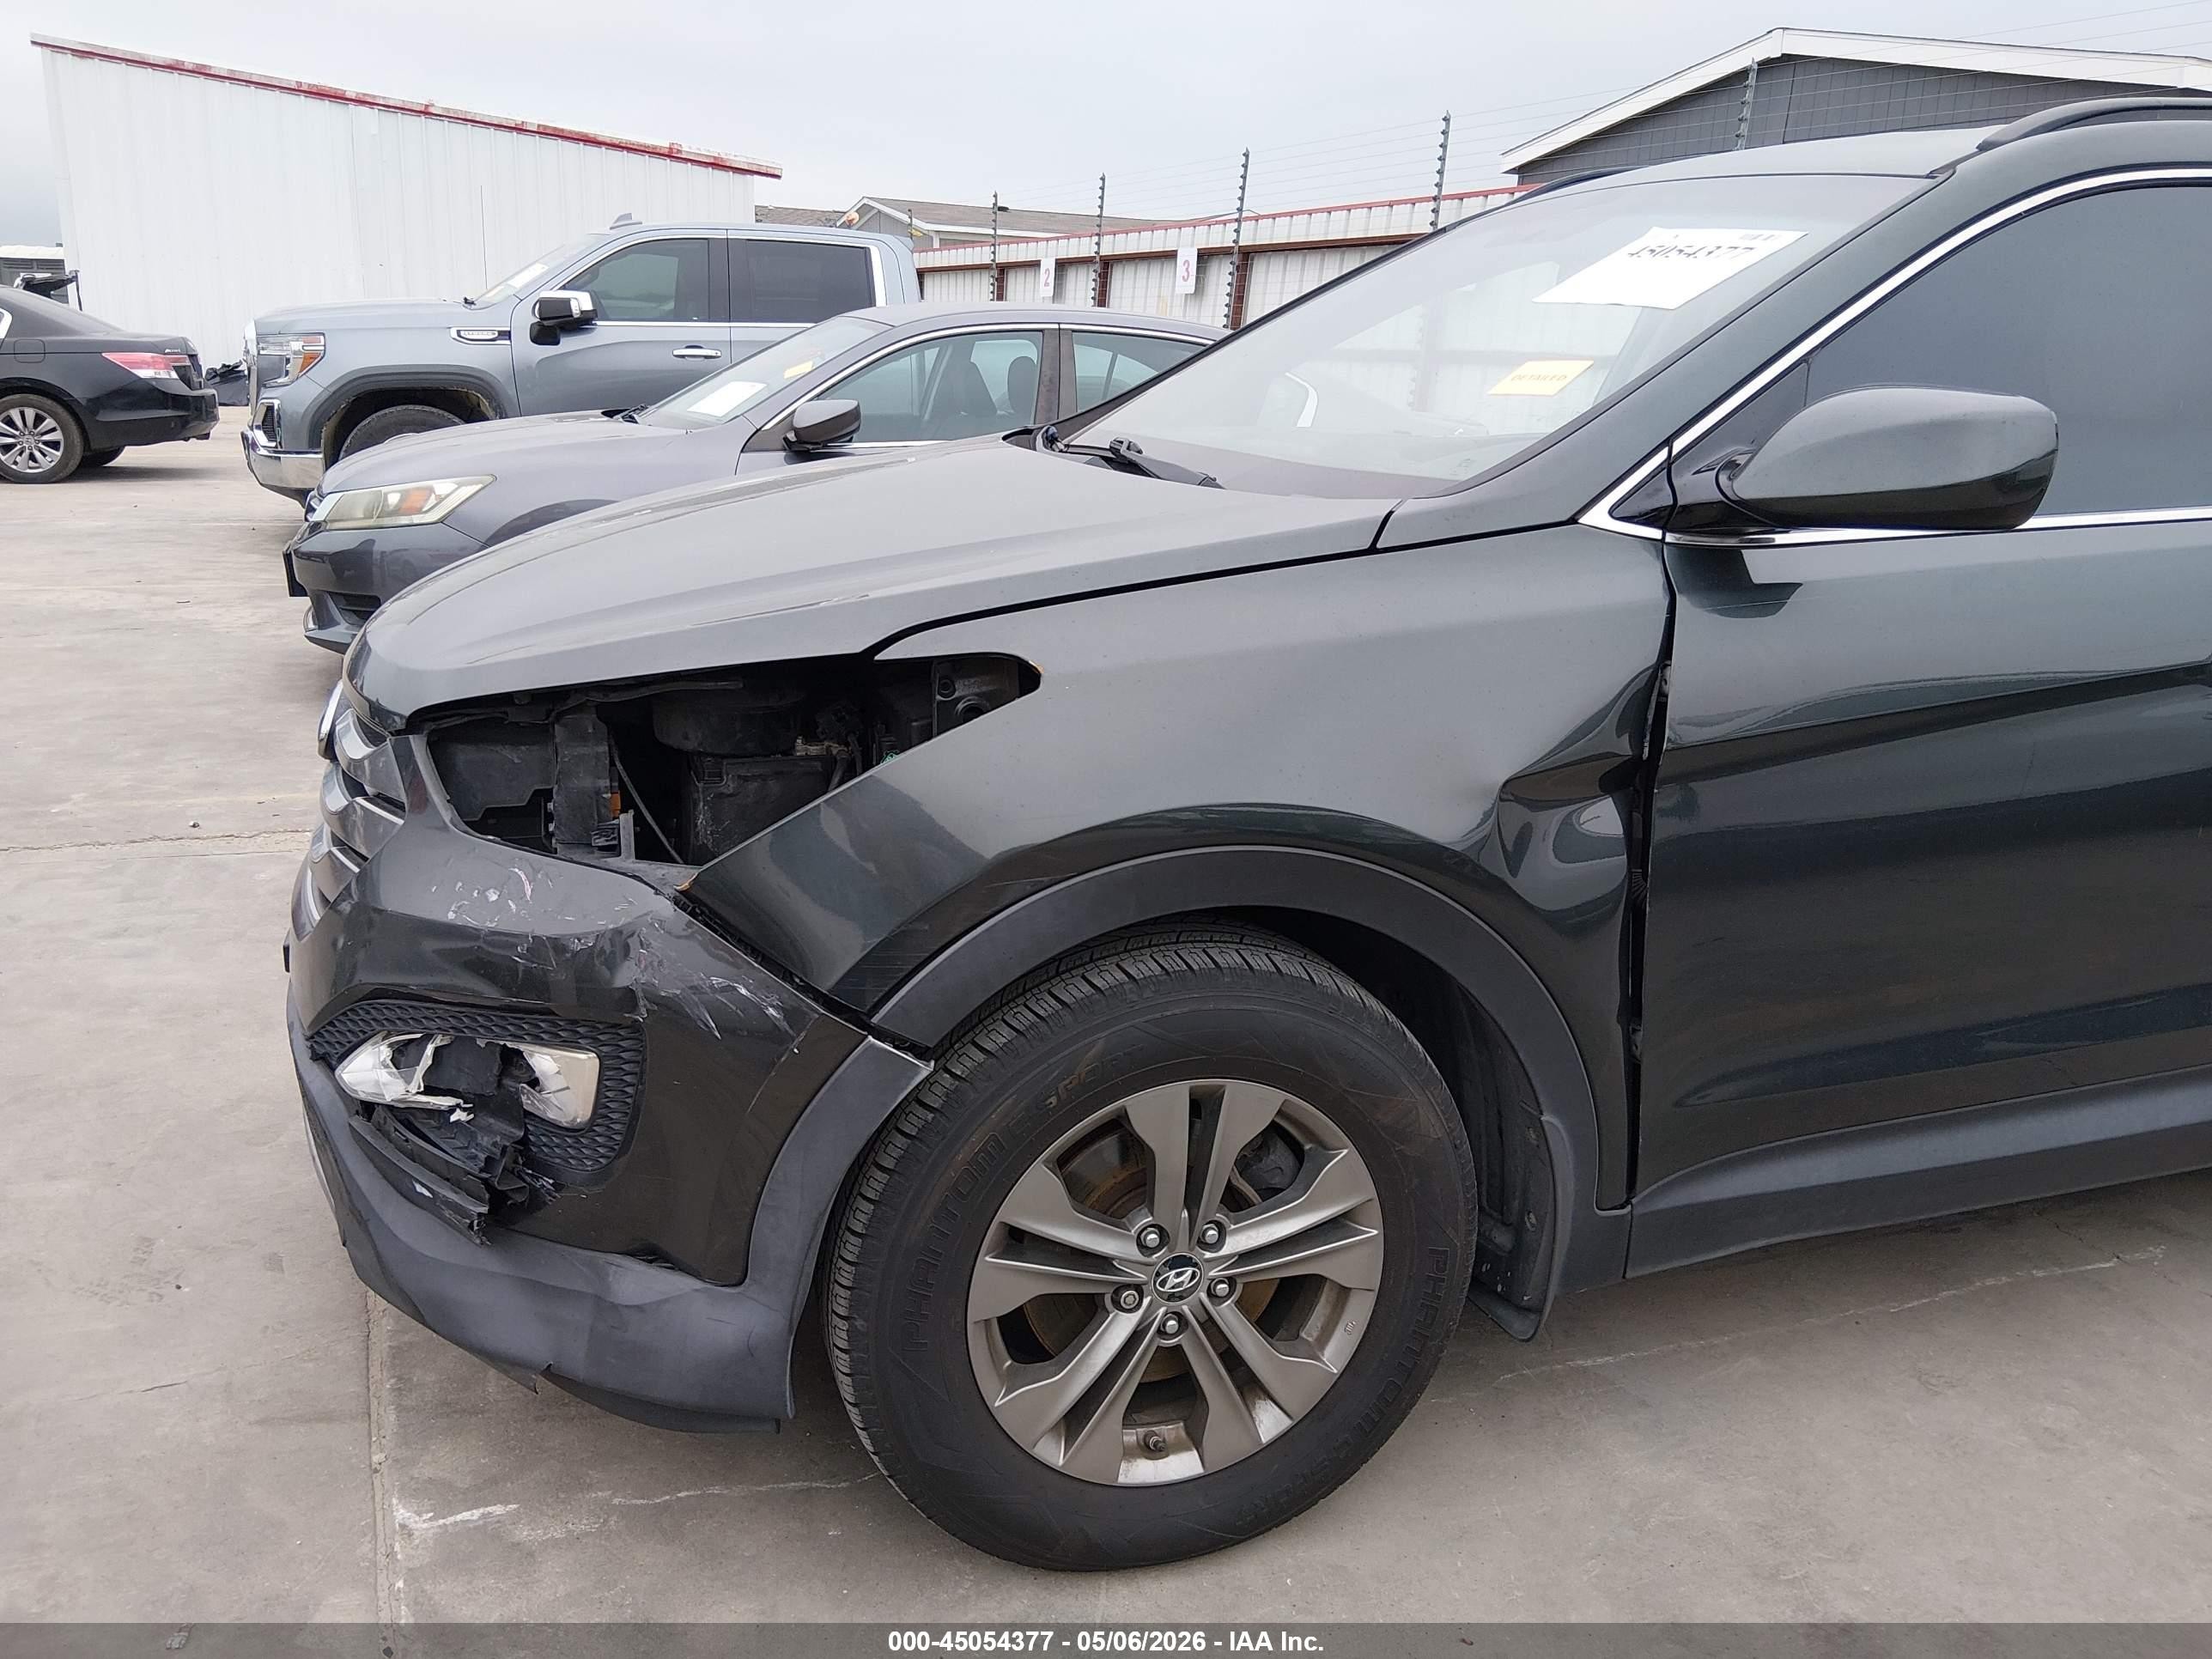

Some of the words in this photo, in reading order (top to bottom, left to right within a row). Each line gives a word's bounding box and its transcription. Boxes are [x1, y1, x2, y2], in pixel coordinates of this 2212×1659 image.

[1043, 267, 1052, 287] 2
[1182, 259, 1191, 283] 3
[902, 1131, 1007, 1352] PHANTOM
